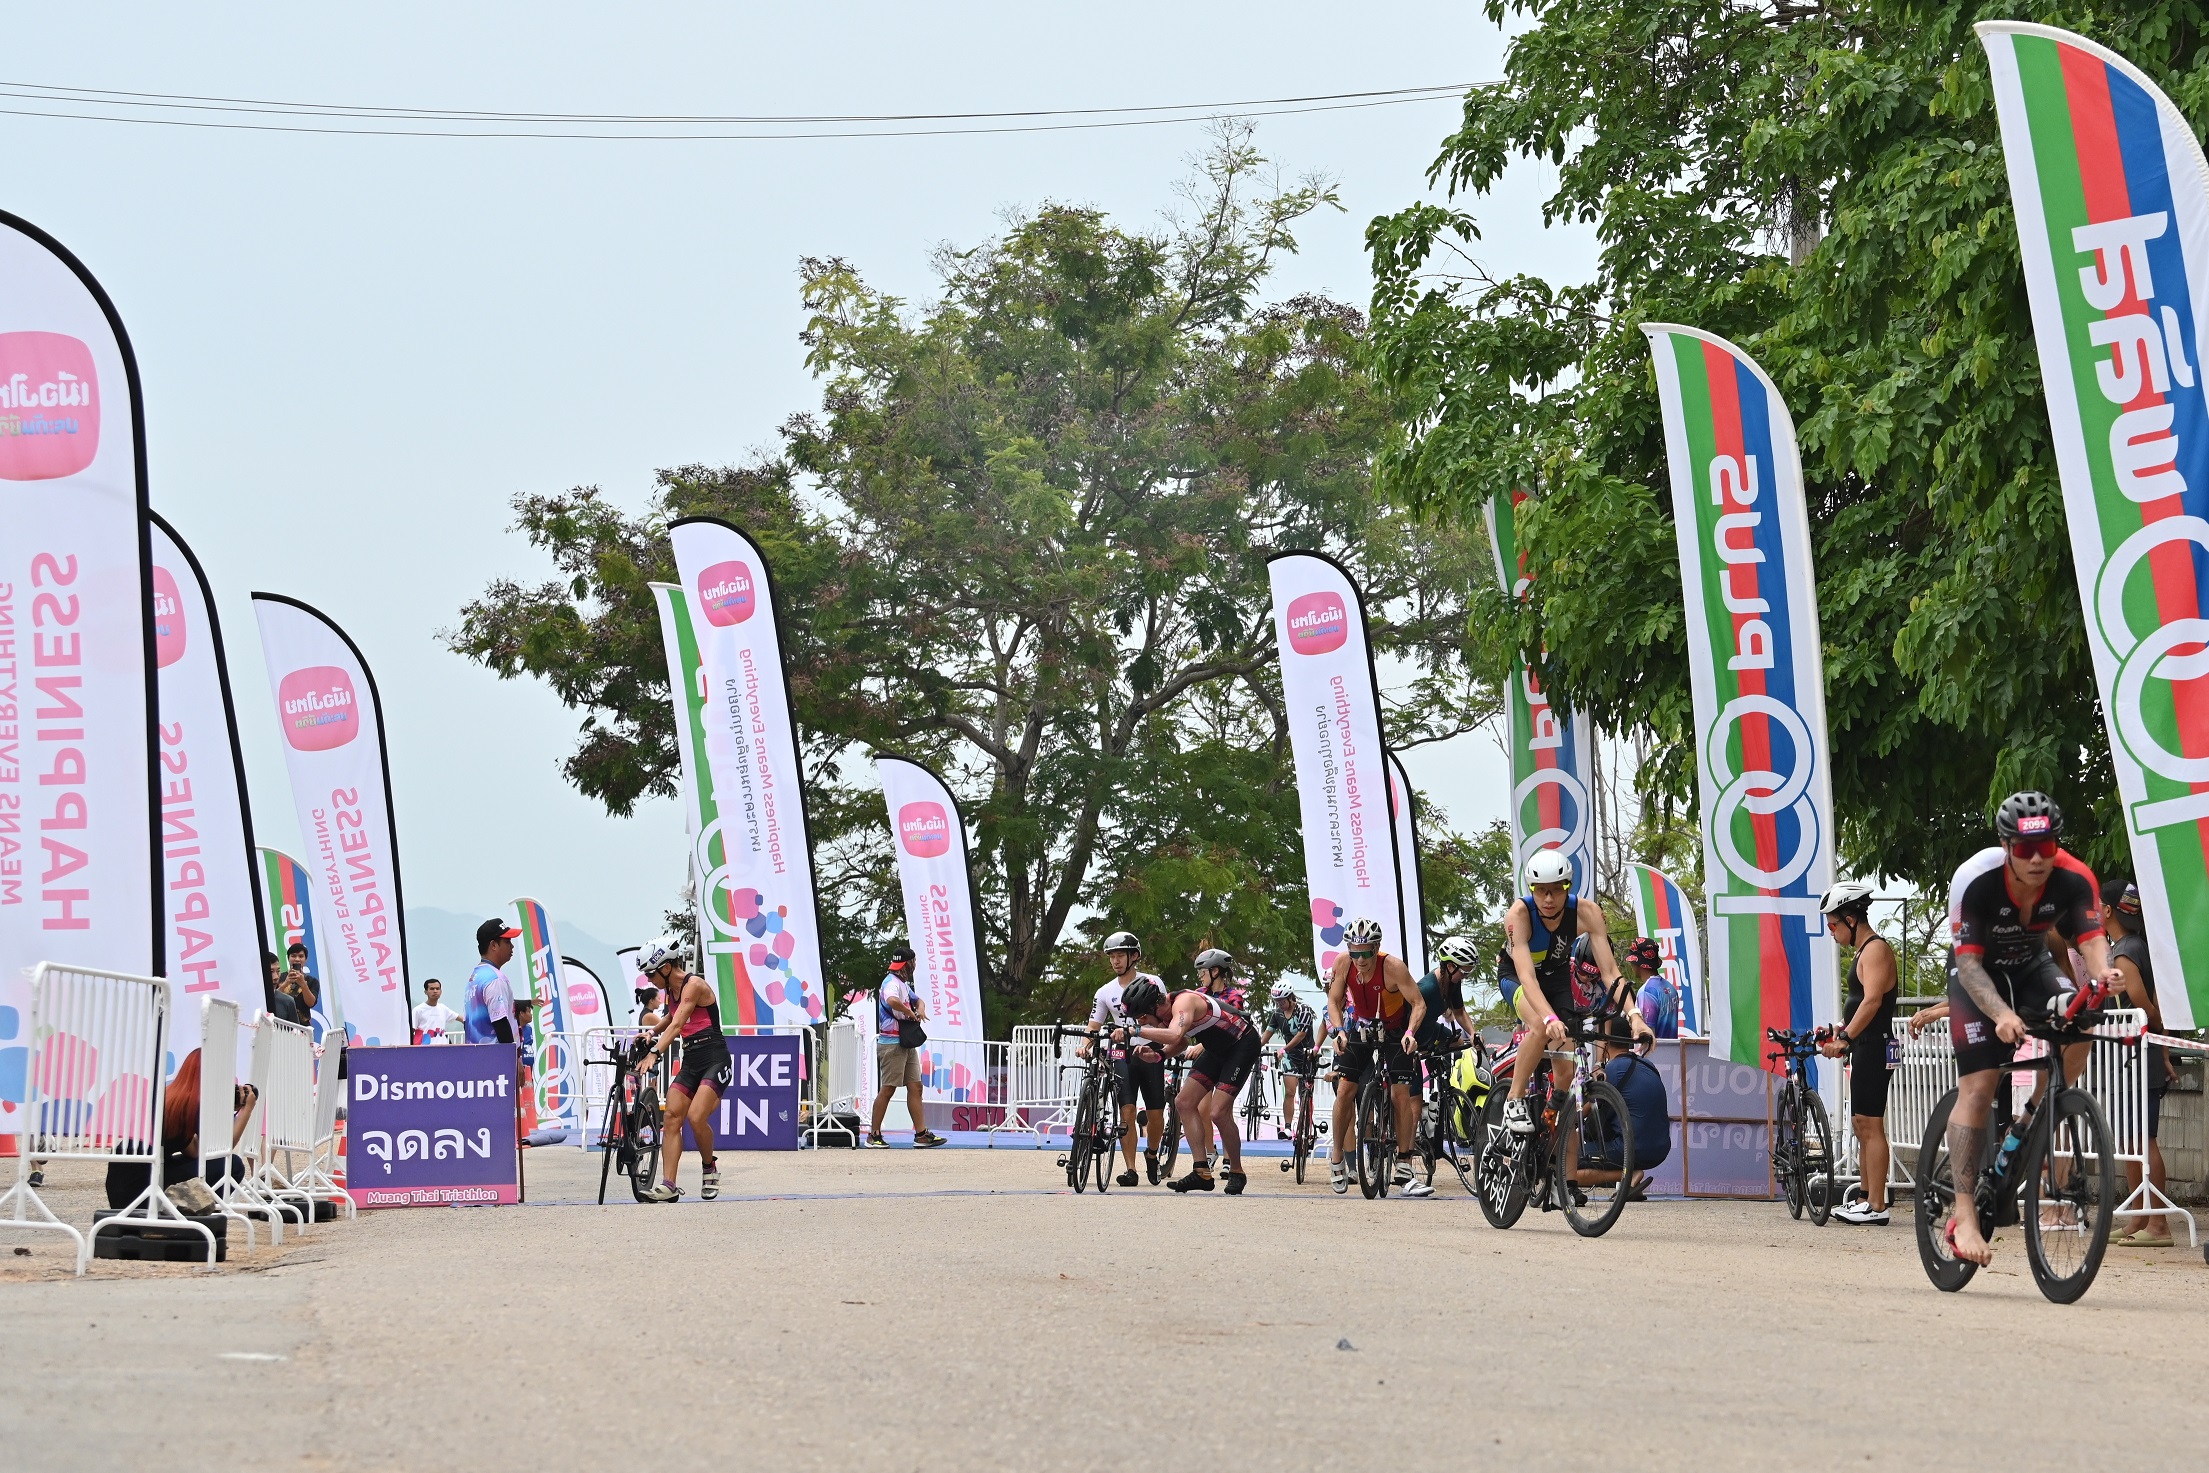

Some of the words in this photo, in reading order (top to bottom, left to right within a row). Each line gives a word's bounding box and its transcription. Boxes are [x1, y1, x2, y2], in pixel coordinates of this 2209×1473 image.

[2022, 819, 2046, 830] 2099
[730, 1054, 791, 1088] KE
[355, 1073, 509, 1101] Dismount
[720, 1099, 769, 1136] IN
[362, 1127, 491, 1174] จุดลง
[367, 1192, 411, 1205] Muang
[412, 1190, 438, 1203] Thai
[440, 1188, 498, 1202] Triathlon
